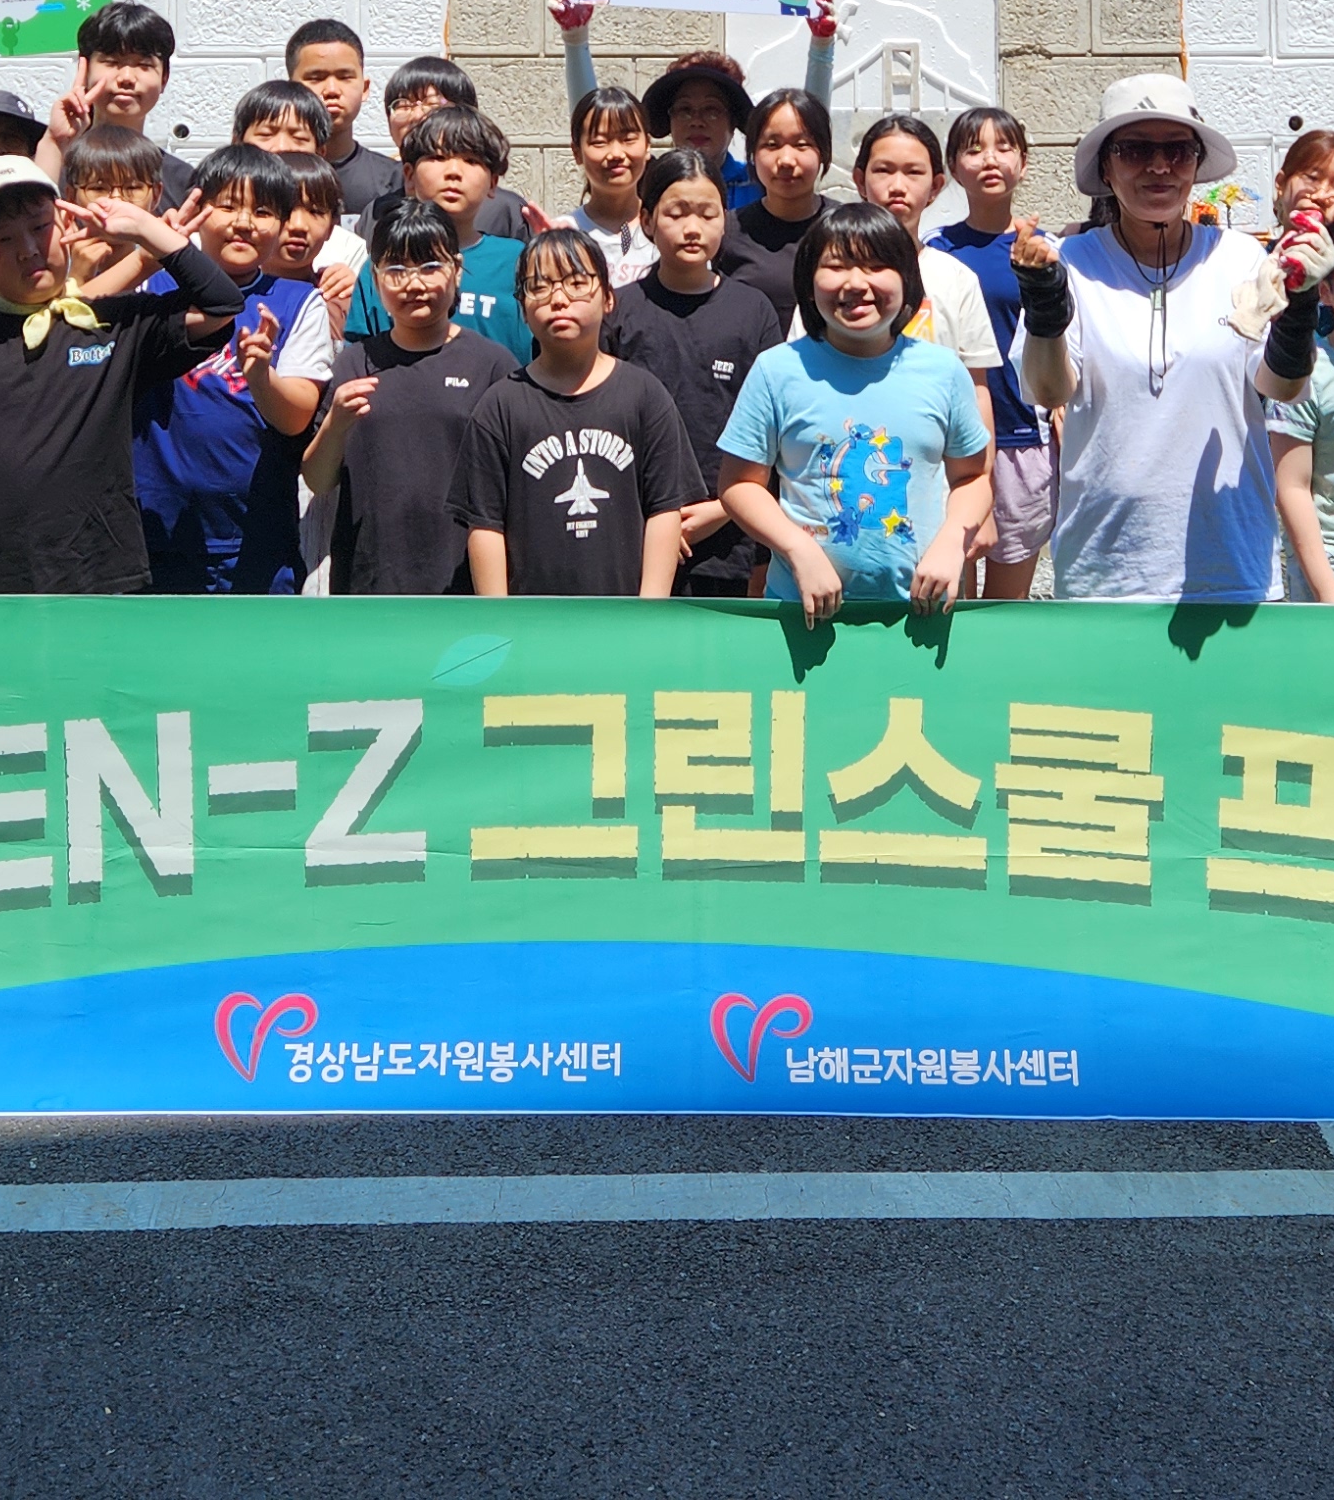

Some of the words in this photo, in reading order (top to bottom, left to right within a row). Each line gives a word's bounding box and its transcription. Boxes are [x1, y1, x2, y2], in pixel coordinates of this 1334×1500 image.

[445, 377, 469, 388] FILA
[522, 435, 564, 480] INTO
[565, 430, 578, 457] A
[470, 690, 1164, 905] 그린스쿨
[284, 1038, 623, 1083] 경상남도자원봉사센터
[784, 1045, 1080, 1088] 남해군자원봉사센터
